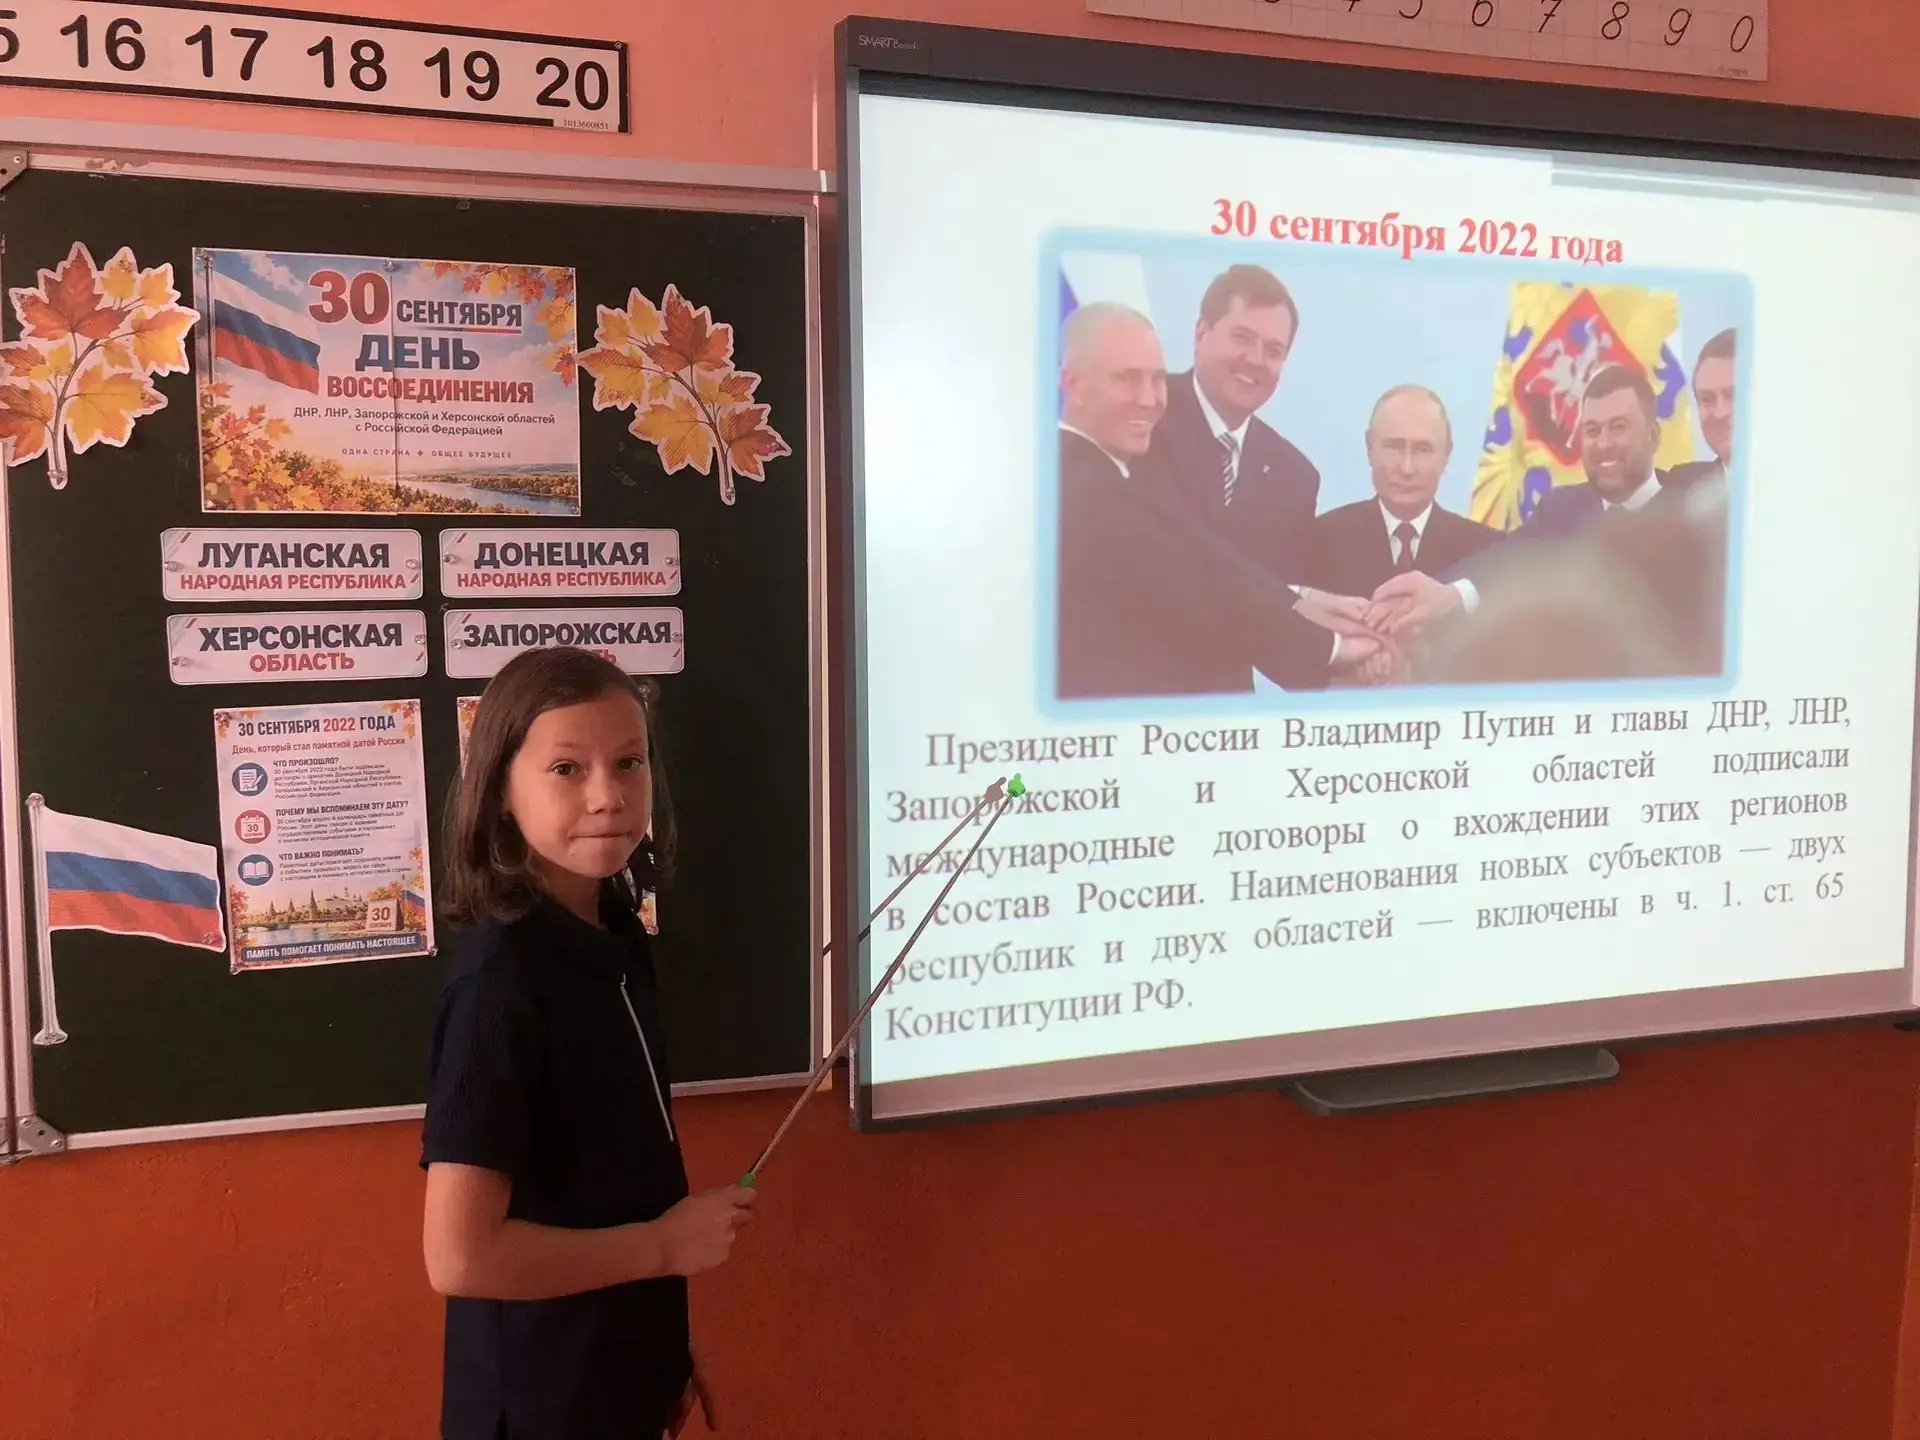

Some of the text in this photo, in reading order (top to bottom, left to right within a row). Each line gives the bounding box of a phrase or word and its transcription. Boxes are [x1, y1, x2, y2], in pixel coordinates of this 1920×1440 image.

[1537, 0, 1562, 33] 7
[1601, 0, 1630, 40] 8
[1663, 8, 1692, 46] 9
[1729, 15, 1754, 53] 0
[858, 35, 891, 48] SMART
[60, 14, 146, 71] 16
[185, 25, 268, 81] 17
[307, 36, 388, 92] 18
[424, 47, 500, 102] 19
[535, 57, 609, 111] 20
[1211, 198, 1624, 267] 30 сентября 2022 года
[308, 270, 522, 327] 30 СЕНТЯБРЯ
[355, 333, 480, 372] ДЕНЬ
[327, 376, 534, 404] ВОССОЕДИНЕНИЯ
[355, 408, 429, 421] Запорожской
[432, 412, 439, 420] и
[441, 411, 505, 424] Херсонской
[507, 413, 555, 424] областей
[355, 422, 503, 437] с Российской Федерацией
[342, 448, 368, 456] ОДНА
[198, 542, 390, 568] ЛУГАНСКАЯ
[474, 541, 650, 570] ДОНЕЦКАЯ
[181, 571, 407, 591] НАРОДНАЯ РЕСПУБЛИКА
[457, 570, 666, 588] НАРОДНАЯ РЕСПУБЛИКА
[199, 622, 402, 652] ХЕРСОНСКАЯ
[463, 621, 671, 648] ЗАПОРОЖСКАЯ
[249, 652, 354, 673] ОБЛАСТЬ
[239, 715, 396, 736] 30 СЕНТЯБРЯ 2022 ГОДА
[925, 696, 1851, 774] Президент России Владимир Путин и главы ДНР, ЛНР,
[257, 742, 291, 753] который
[293, 741, 311, 751] стал
[312, 739, 351, 749] памятной
[353, 737, 376, 749] датой
[377, 736, 406, 747] России
[273, 757, 339, 768] ЧТО ПРОИЗОШЛО?
[1196, 779, 1216, 804] и
[1286, 760, 1470, 803] Херсонской
[1533, 750, 1656, 784] областей
[1712, 746, 1849, 777] подписали
[276, 808, 304, 817] ПОЧЕМУ
[306, 806, 320, 814] МЫ
[321, 803, 371, 814] ВСПОМИНАЕМ
[386, 800, 409, 810] ДАТУ?
[247, 823, 259, 832] 30
[886, 791, 1848, 879] международные договоры о вхождении этих регионов
[279, 847, 365, 861] ЧТО ВАЖНО ПОНИМАТЬ?
[886, 908, 906, 932] в
[931, 893, 1050, 926] состав
[1077, 882, 1204, 915] России.
[1230, 860, 1459, 902] Наименования
[1480, 853, 1569, 882] новых
[1588, 841, 1722, 877] субъектов
[1787, 831, 1847, 866] двух
[371, 906, 391, 922] 30
[884, 940, 1075, 994] республик
[1104, 940, 1124, 964] и
[1151, 929, 1228, 963] двух
[1253, 910, 1393, 950] областей
[1476, 896, 1618, 930] включены
[1640, 892, 1654, 914] в
[1676, 889, 1698, 911] ч.
[1721, 880, 1741, 908] 1.
[1764, 880, 1794, 904] ст.
[1816, 871, 1845, 900] 65
[246, 935, 417, 959] ПАМЯТЬ ПОМОГАЕТ ПОНИМАТЬ НАСТОЯЩЕЕ
[885, 976, 1195, 1041] Конституции РФ.
